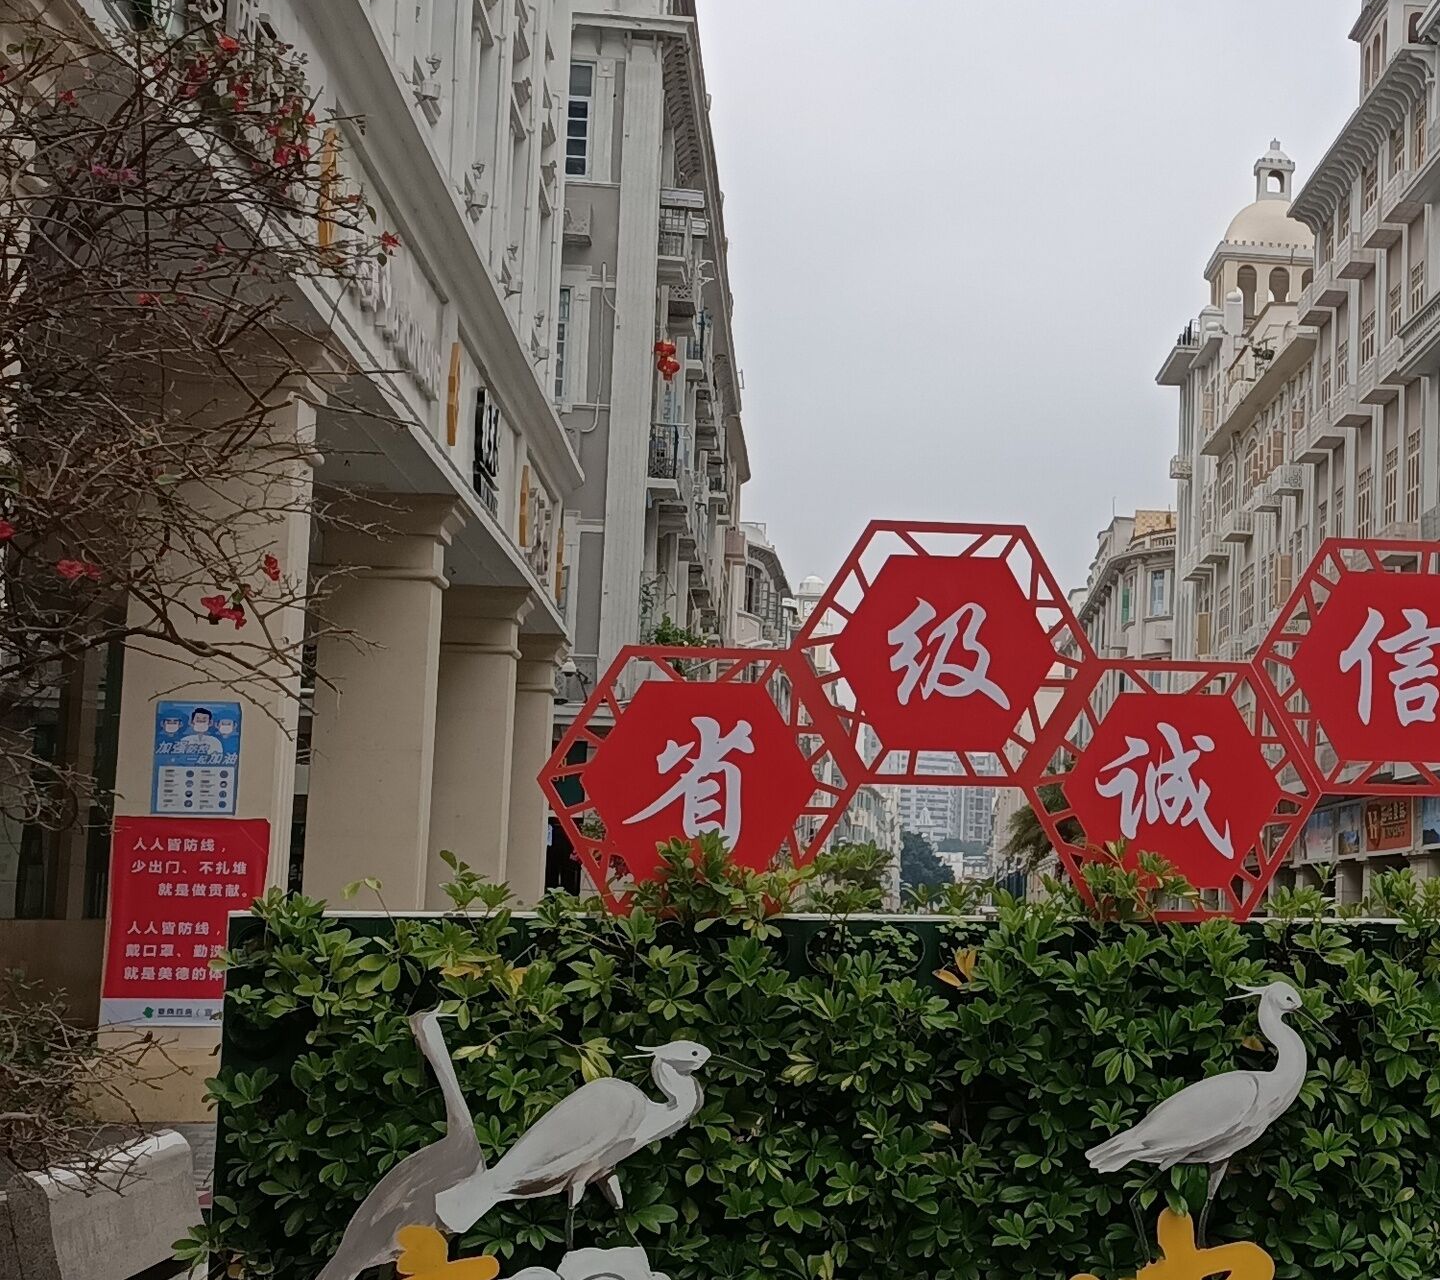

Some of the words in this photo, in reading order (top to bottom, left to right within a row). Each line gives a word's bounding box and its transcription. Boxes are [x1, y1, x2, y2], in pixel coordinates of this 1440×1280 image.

[130, 859, 248, 876] 少出门、不扎堆
